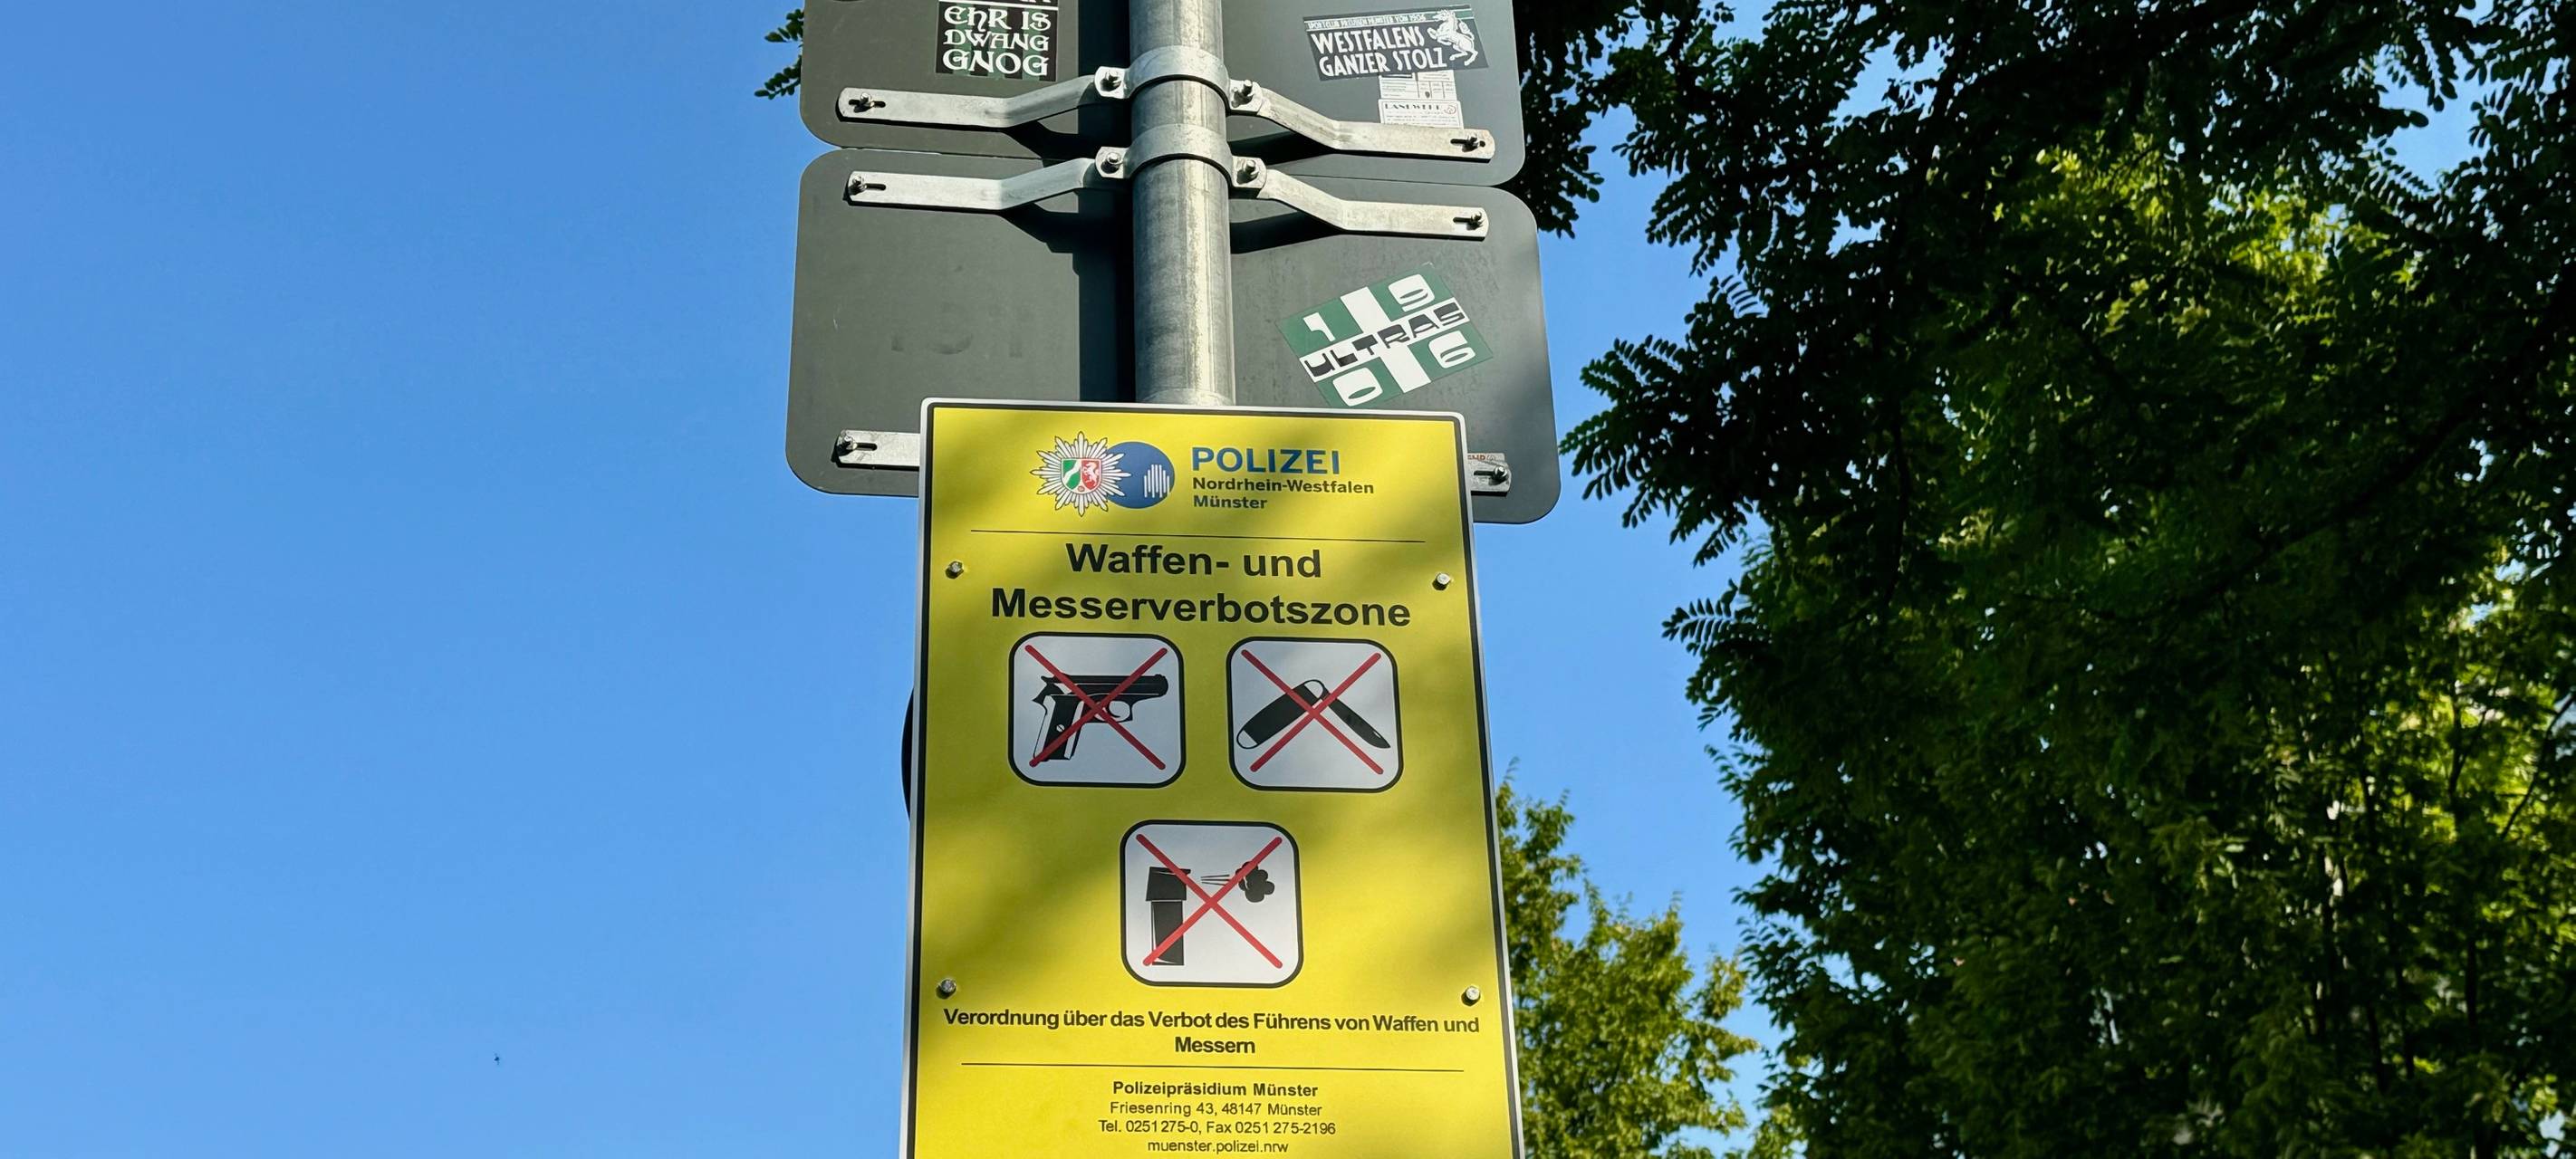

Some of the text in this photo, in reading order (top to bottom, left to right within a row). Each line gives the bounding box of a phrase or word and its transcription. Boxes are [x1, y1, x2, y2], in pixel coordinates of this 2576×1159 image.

[943, 29, 1049, 51] DWANG
[1312, 25, 1425, 54] WESTFALENS
[943, 49, 1049, 76] GNOG
[1319, 47, 1447, 77] GANZER STOLZ
[1304, 302, 1466, 377] ULTRAS
[1192, 446, 1340, 474] POLIZEI
[1192, 477, 1374, 494] Nordrhein-Westfalen
[1193, 494, 1267, 510] Münster
[1066, 542, 1322, 579] Waffen- und
[991, 588, 1410, 627] Messerverbotszone
[944, 1008, 1480, 1033] Verordnung über das Verbot des Führens von Waffen und
[1175, 1037, 1256, 1054] Messern
[1113, 1081, 1319, 1098] Polizeipräsidium Münster
[1110, 1101, 1322, 1118] Friesenring 43, 48147 Münster
[1099, 1119, 1336, 1135] Tel. 0251 275-0, Fax 0251 275-2196
[1148, 1140, 1288, 1155] muenster.polizei.nrw
